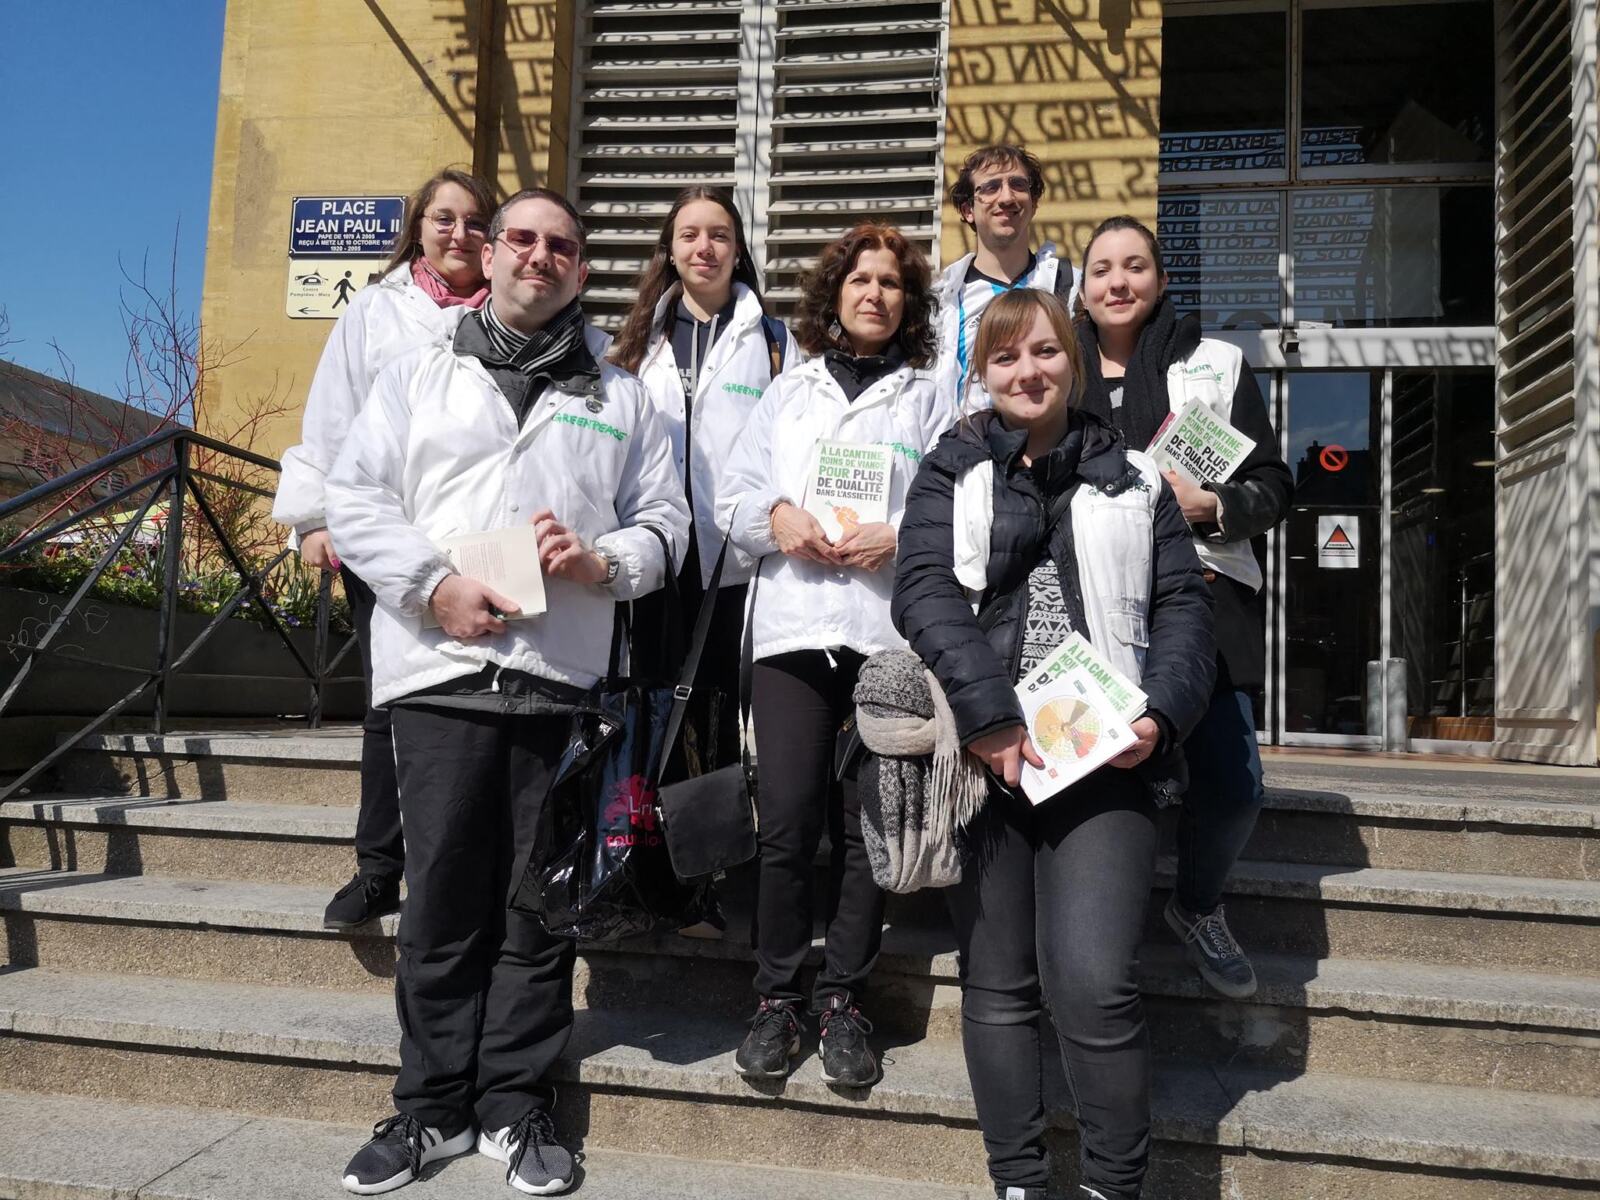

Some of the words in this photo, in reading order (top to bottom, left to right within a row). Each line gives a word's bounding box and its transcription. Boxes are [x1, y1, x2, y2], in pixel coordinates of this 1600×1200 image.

[321, 201, 376, 215] PLACE
[295, 219, 339, 234] JEAN
[343, 219, 386, 233] PAUL
[390, 219, 400, 233] II
[1196, 411, 1209, 426] LA
[1170, 434, 1186, 451] DE
[1178, 424, 1204, 450] POUR
[1202, 446, 1230, 472] PLUS
[829, 447, 841, 457] LA
[1164, 444, 1181, 465] DANS
[820, 457, 843, 466] MOINS
[845, 459, 855, 467] DE
[819, 466, 850, 478] POUR
[853, 469, 884, 482] PLUS
[817, 477, 832, 488] DE
[816, 489, 835, 497] DANS
[1068, 641, 1080, 655] À
[1076, 650, 1092, 667] LA
